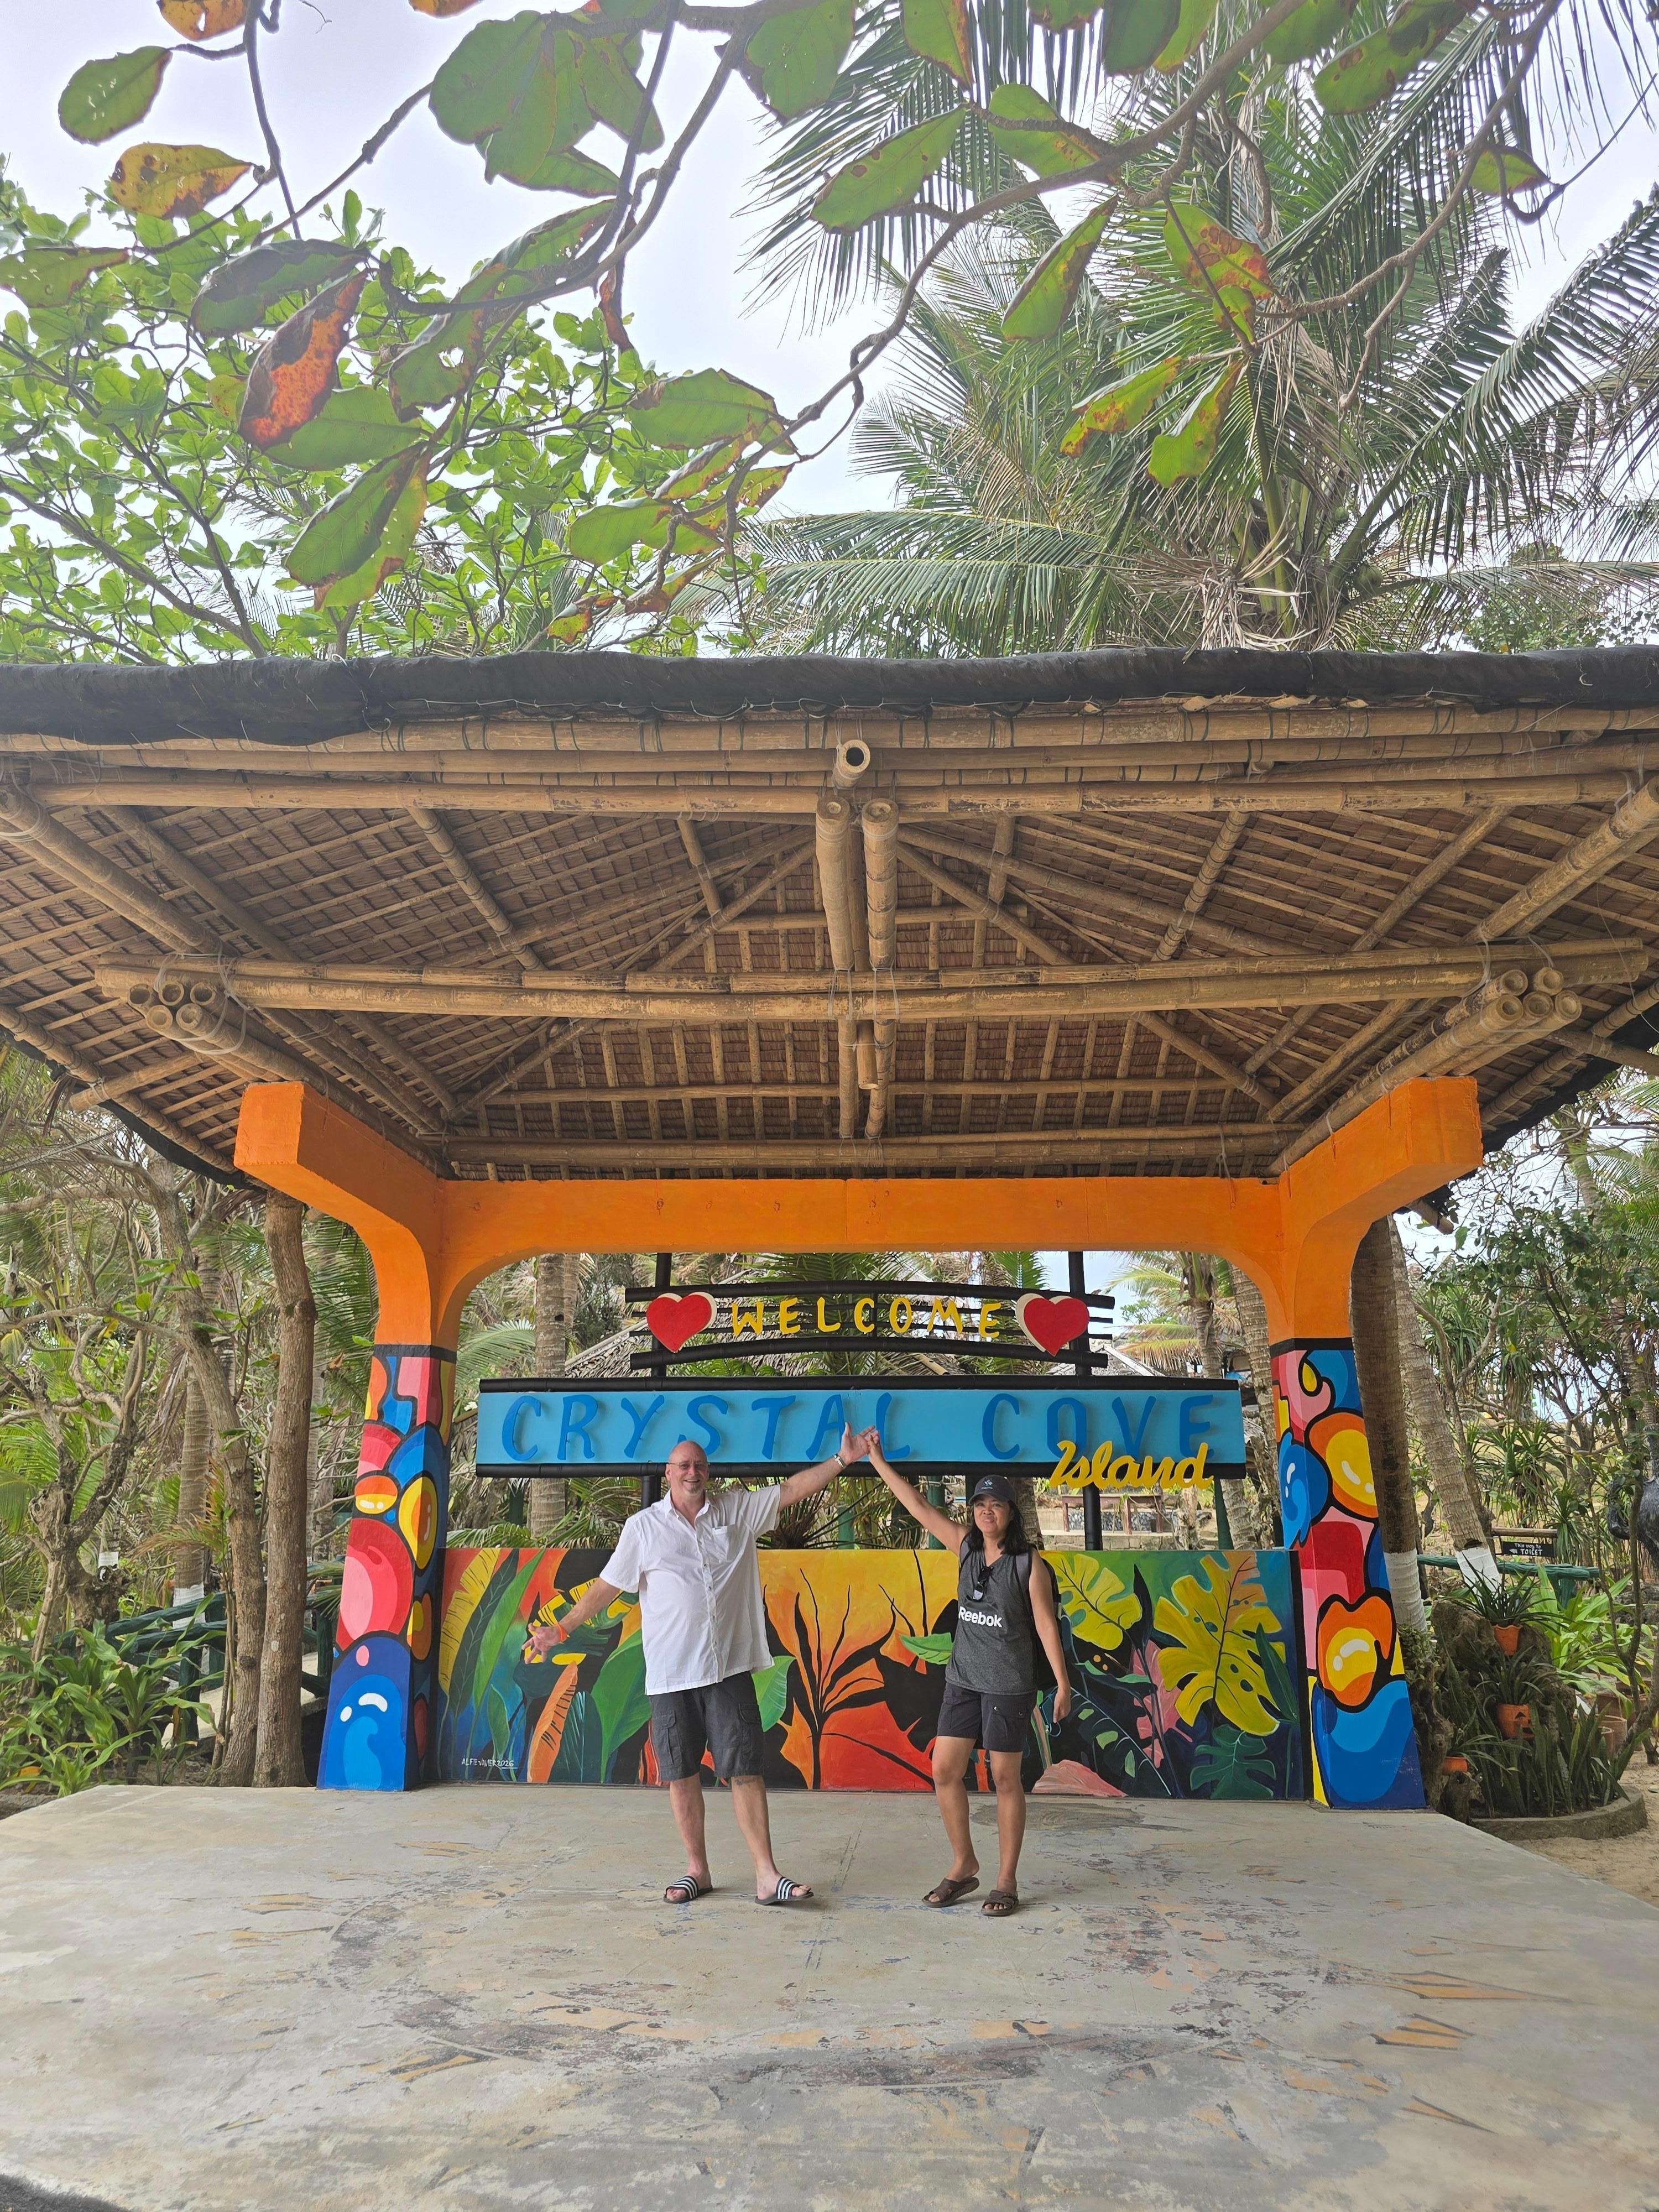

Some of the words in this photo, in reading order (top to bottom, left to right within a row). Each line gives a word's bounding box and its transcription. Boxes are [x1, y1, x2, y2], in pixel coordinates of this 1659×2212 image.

[731, 1296, 1002, 1338] WELCOME
[502, 1392, 910, 1461] CRYSTAL
[982, 1392, 1214, 1460] COVE
[1050, 1440, 1214, 1490] Island
[958, 1606, 1003, 1627] Reebok
[497, 1759, 514, 1767] 2026
